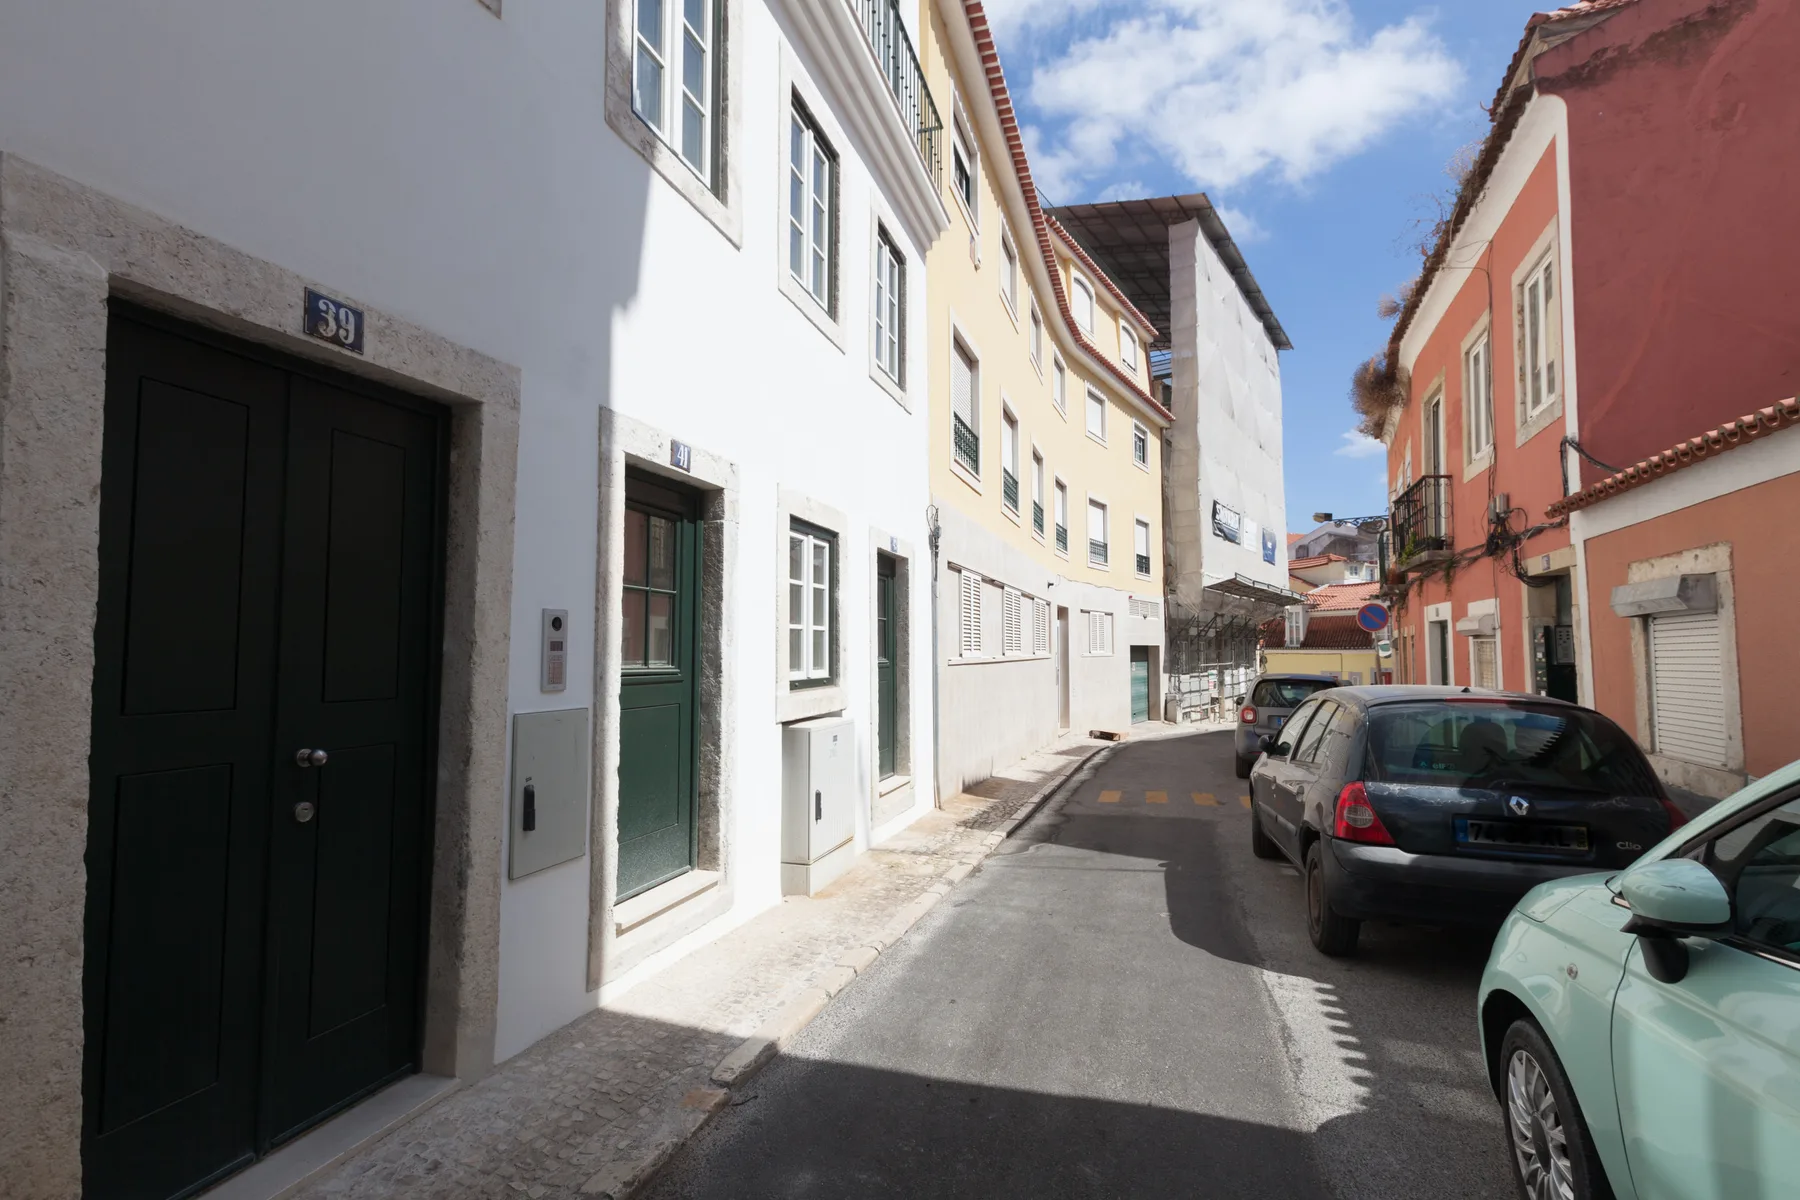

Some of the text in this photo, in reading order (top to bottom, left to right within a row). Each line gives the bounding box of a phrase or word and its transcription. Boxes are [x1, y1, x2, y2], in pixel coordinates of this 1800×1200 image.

[317, 299, 355, 344] 39
[677, 444, 688, 468] 41
[1615, 840, 1643, 851] Clio
